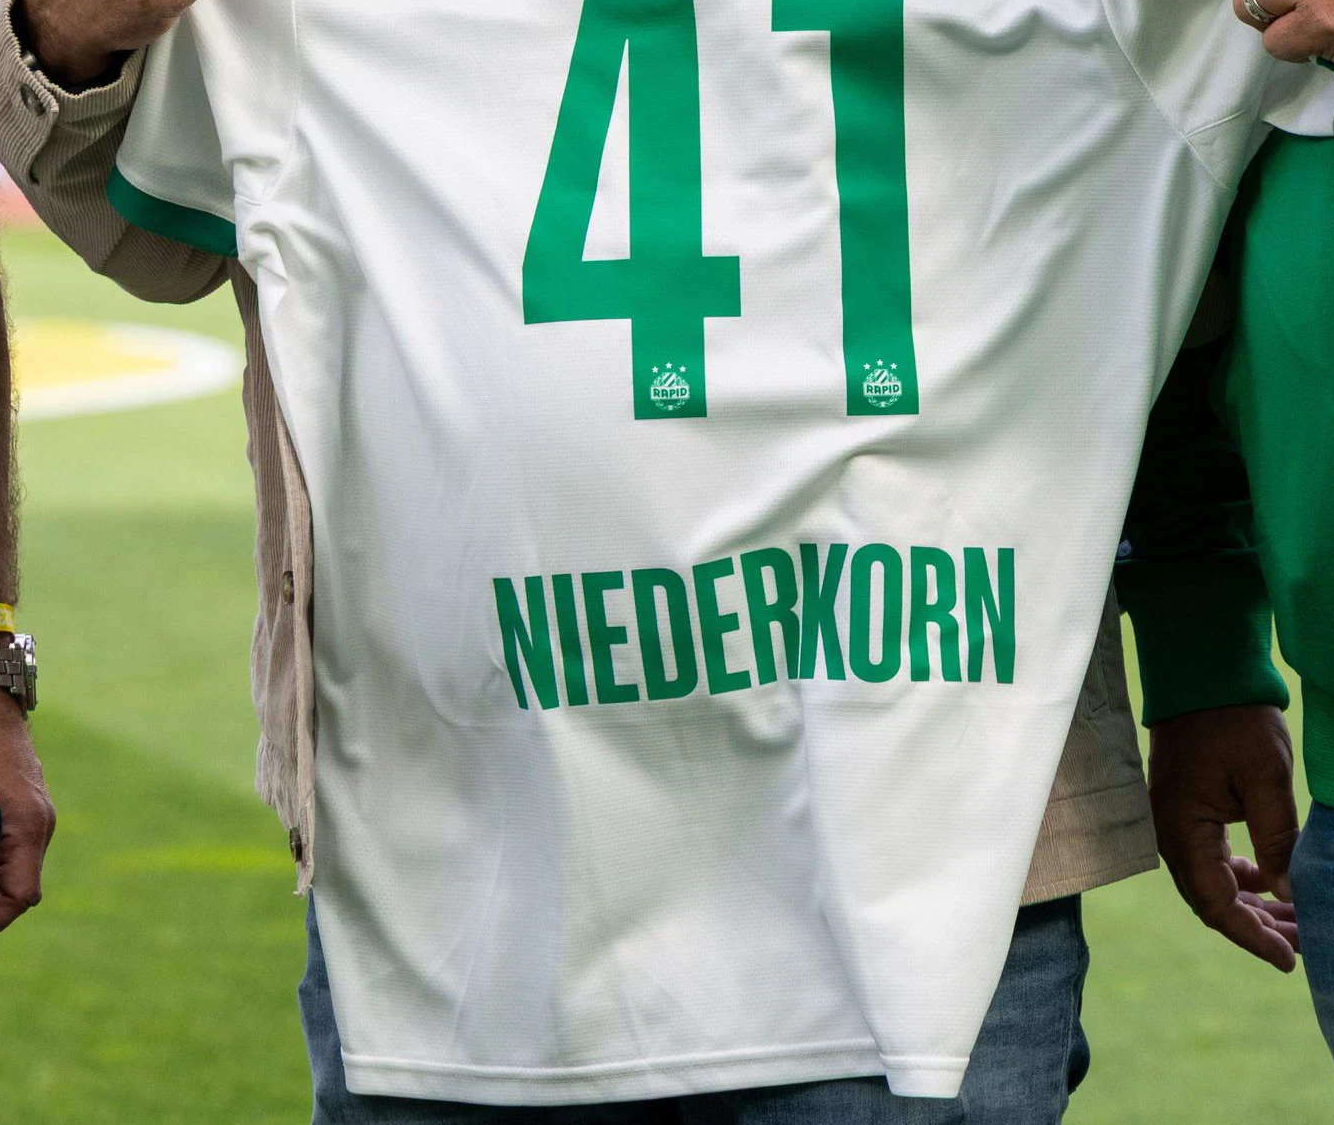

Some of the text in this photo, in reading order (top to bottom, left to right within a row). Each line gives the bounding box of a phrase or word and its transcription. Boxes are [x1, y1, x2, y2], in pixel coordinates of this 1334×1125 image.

[652, 387, 688, 398] RAPID
[866, 383, 900, 394] RAPID
[493, 542, 1015, 711] NIEDERKORN
